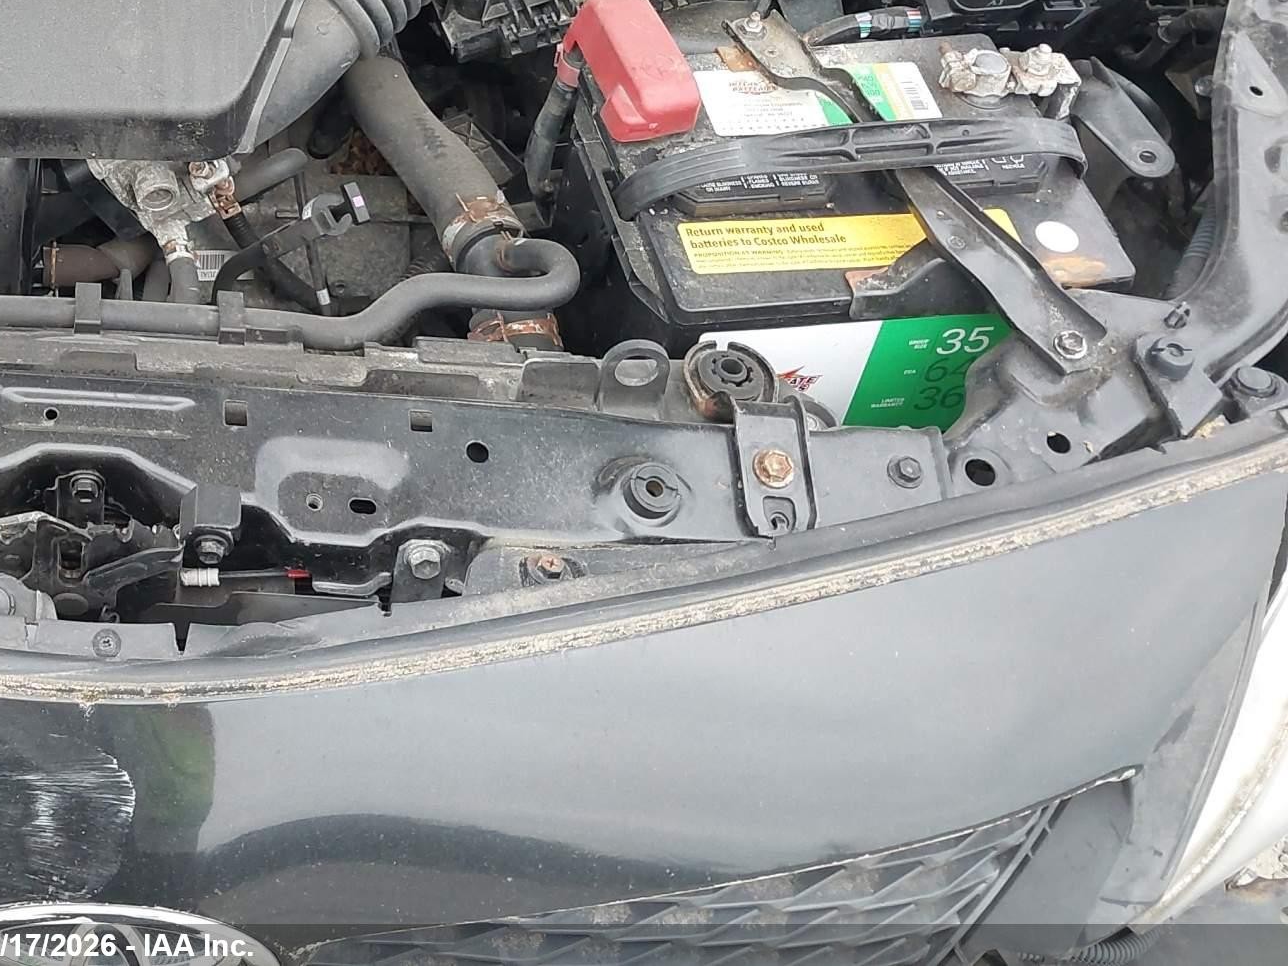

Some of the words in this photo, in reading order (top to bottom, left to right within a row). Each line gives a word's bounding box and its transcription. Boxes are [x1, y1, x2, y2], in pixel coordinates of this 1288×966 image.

[686, 227, 723, 238] Return
[725, 225, 774, 237] warranty
[776, 223, 796, 234] and
[798, 222, 825, 233] used
[690, 237, 740, 249] batteries
[741, 236, 752, 246] to
[753, 235, 788, 247] Costco
[789, 234, 847, 245] Wholesale
[935, 326, 994, 355] 35
